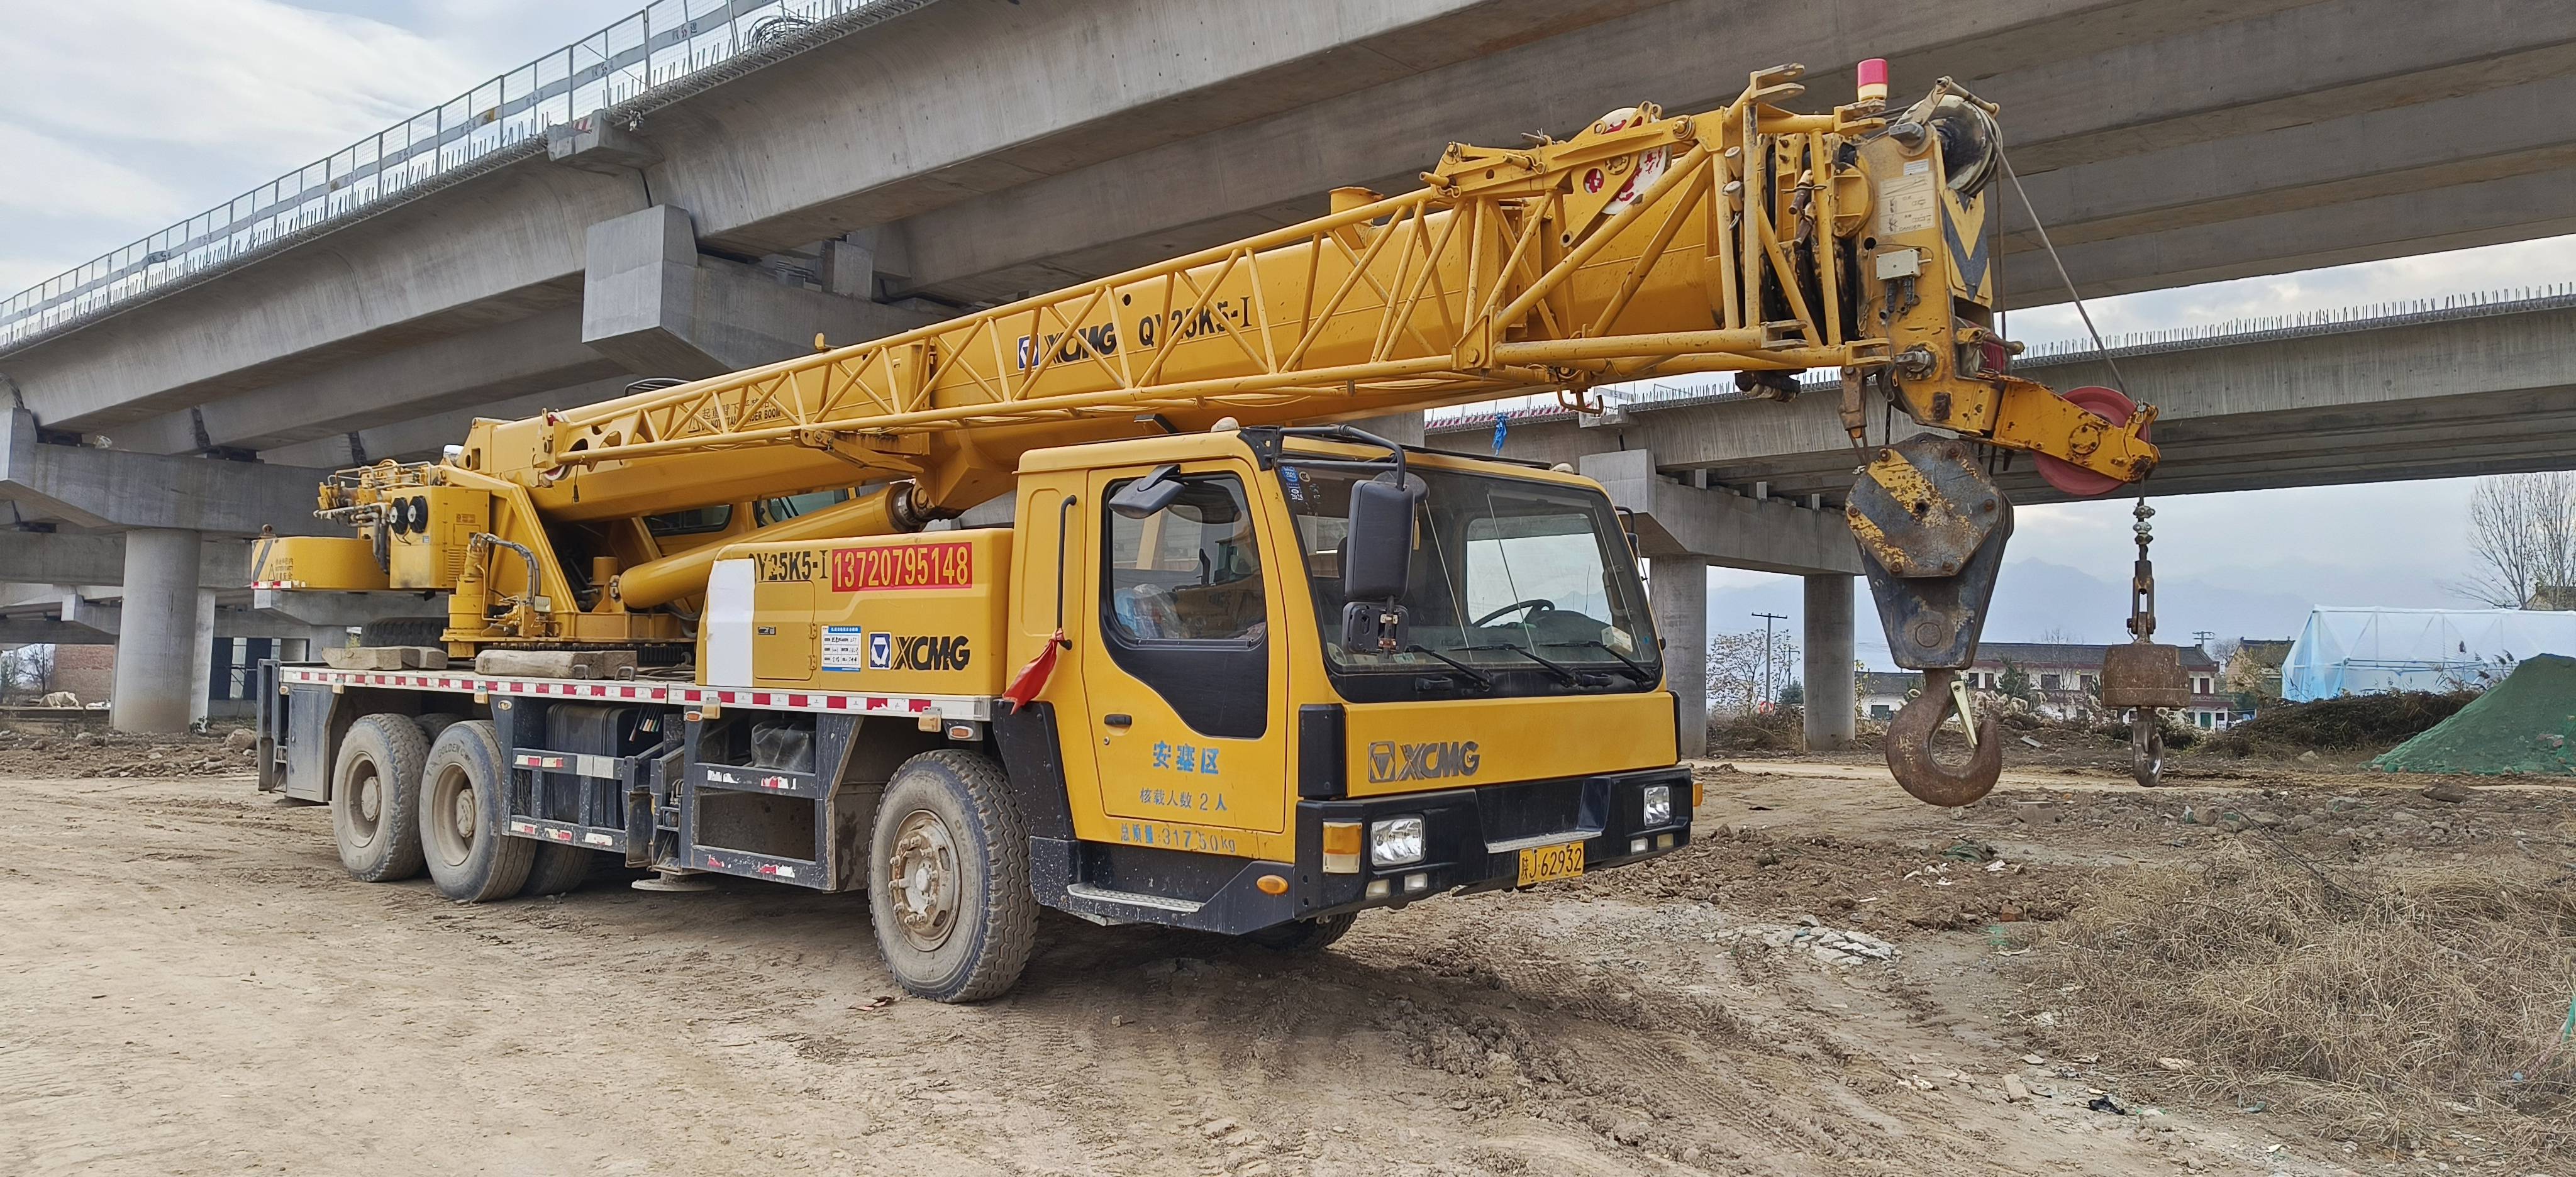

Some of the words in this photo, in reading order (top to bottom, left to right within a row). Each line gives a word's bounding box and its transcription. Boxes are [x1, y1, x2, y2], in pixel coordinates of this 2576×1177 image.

[834, 546, 969, 588] 13720795148
[891, 636, 970, 671] XCMG
[1152, 740, 1220, 775] 安塞区
[1394, 741, 1480, 782] XCMG
